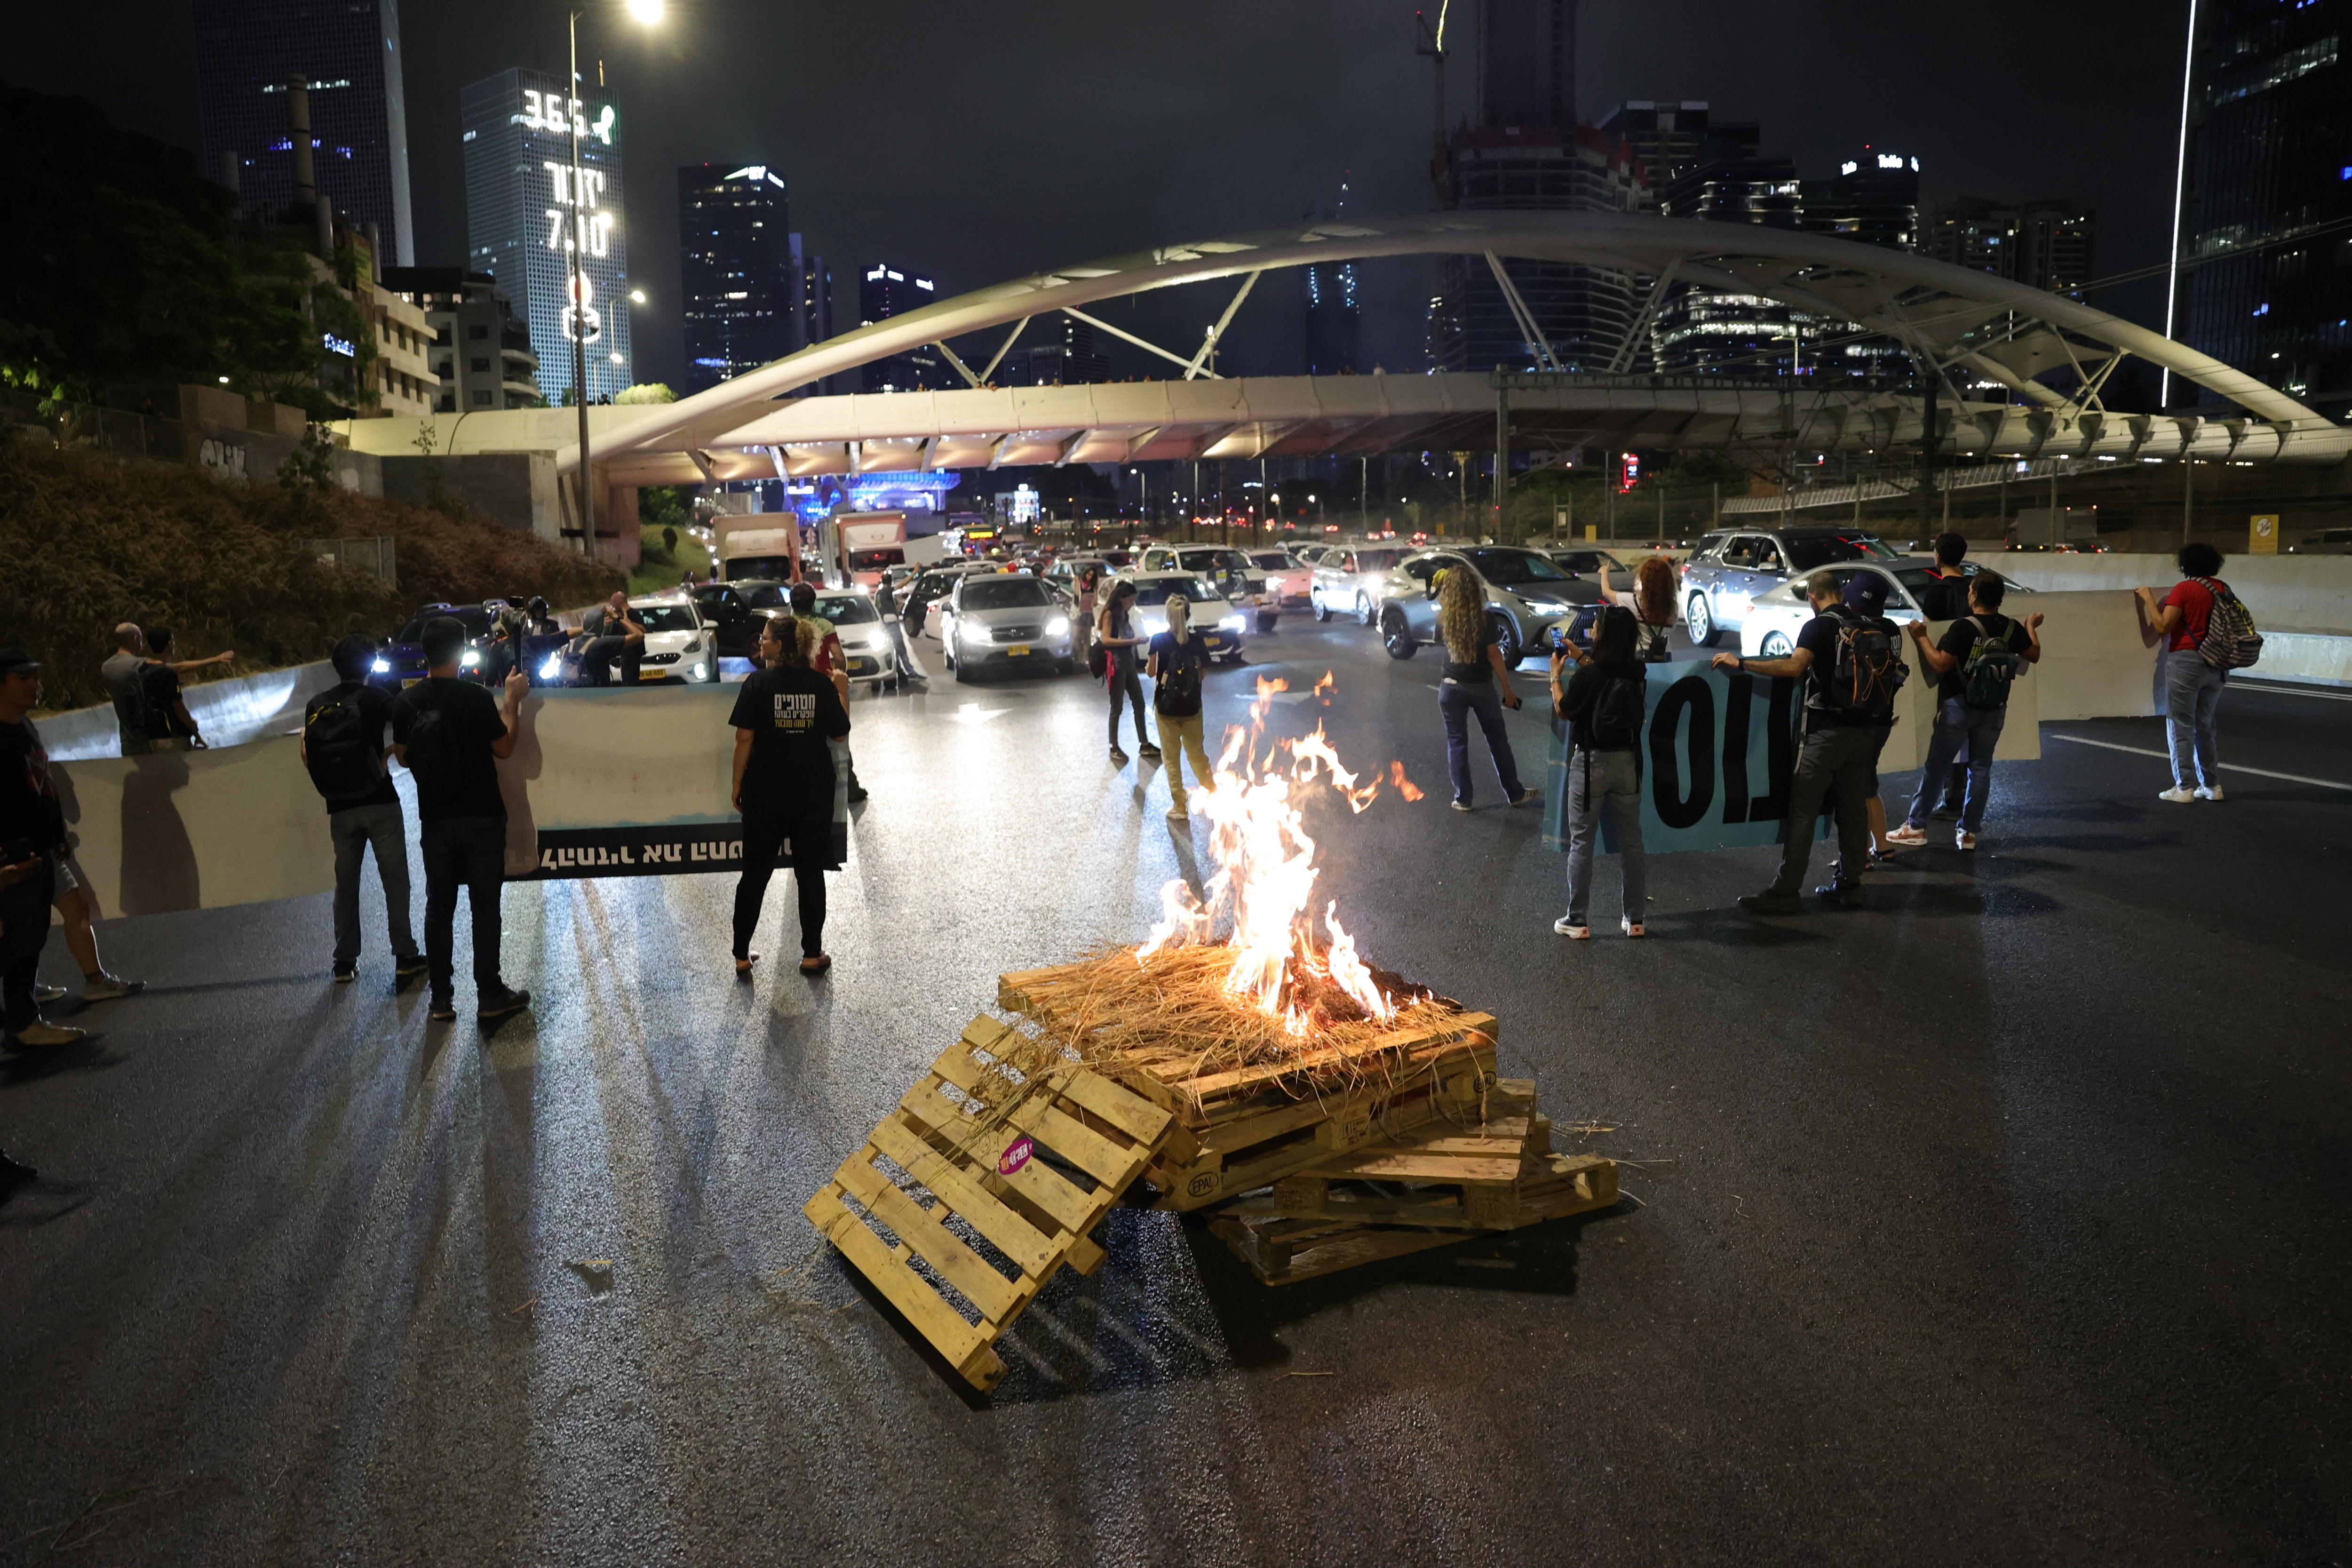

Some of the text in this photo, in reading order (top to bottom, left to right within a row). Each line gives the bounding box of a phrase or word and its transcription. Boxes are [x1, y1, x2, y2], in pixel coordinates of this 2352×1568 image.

[524, 90, 585, 136] 365
[774, 694, 815, 710] חטופים
[541, 846, 635, 870] להחזיר
[643, 844, 682, 863] את
[1192, 1176, 1214, 1194] EPAL
